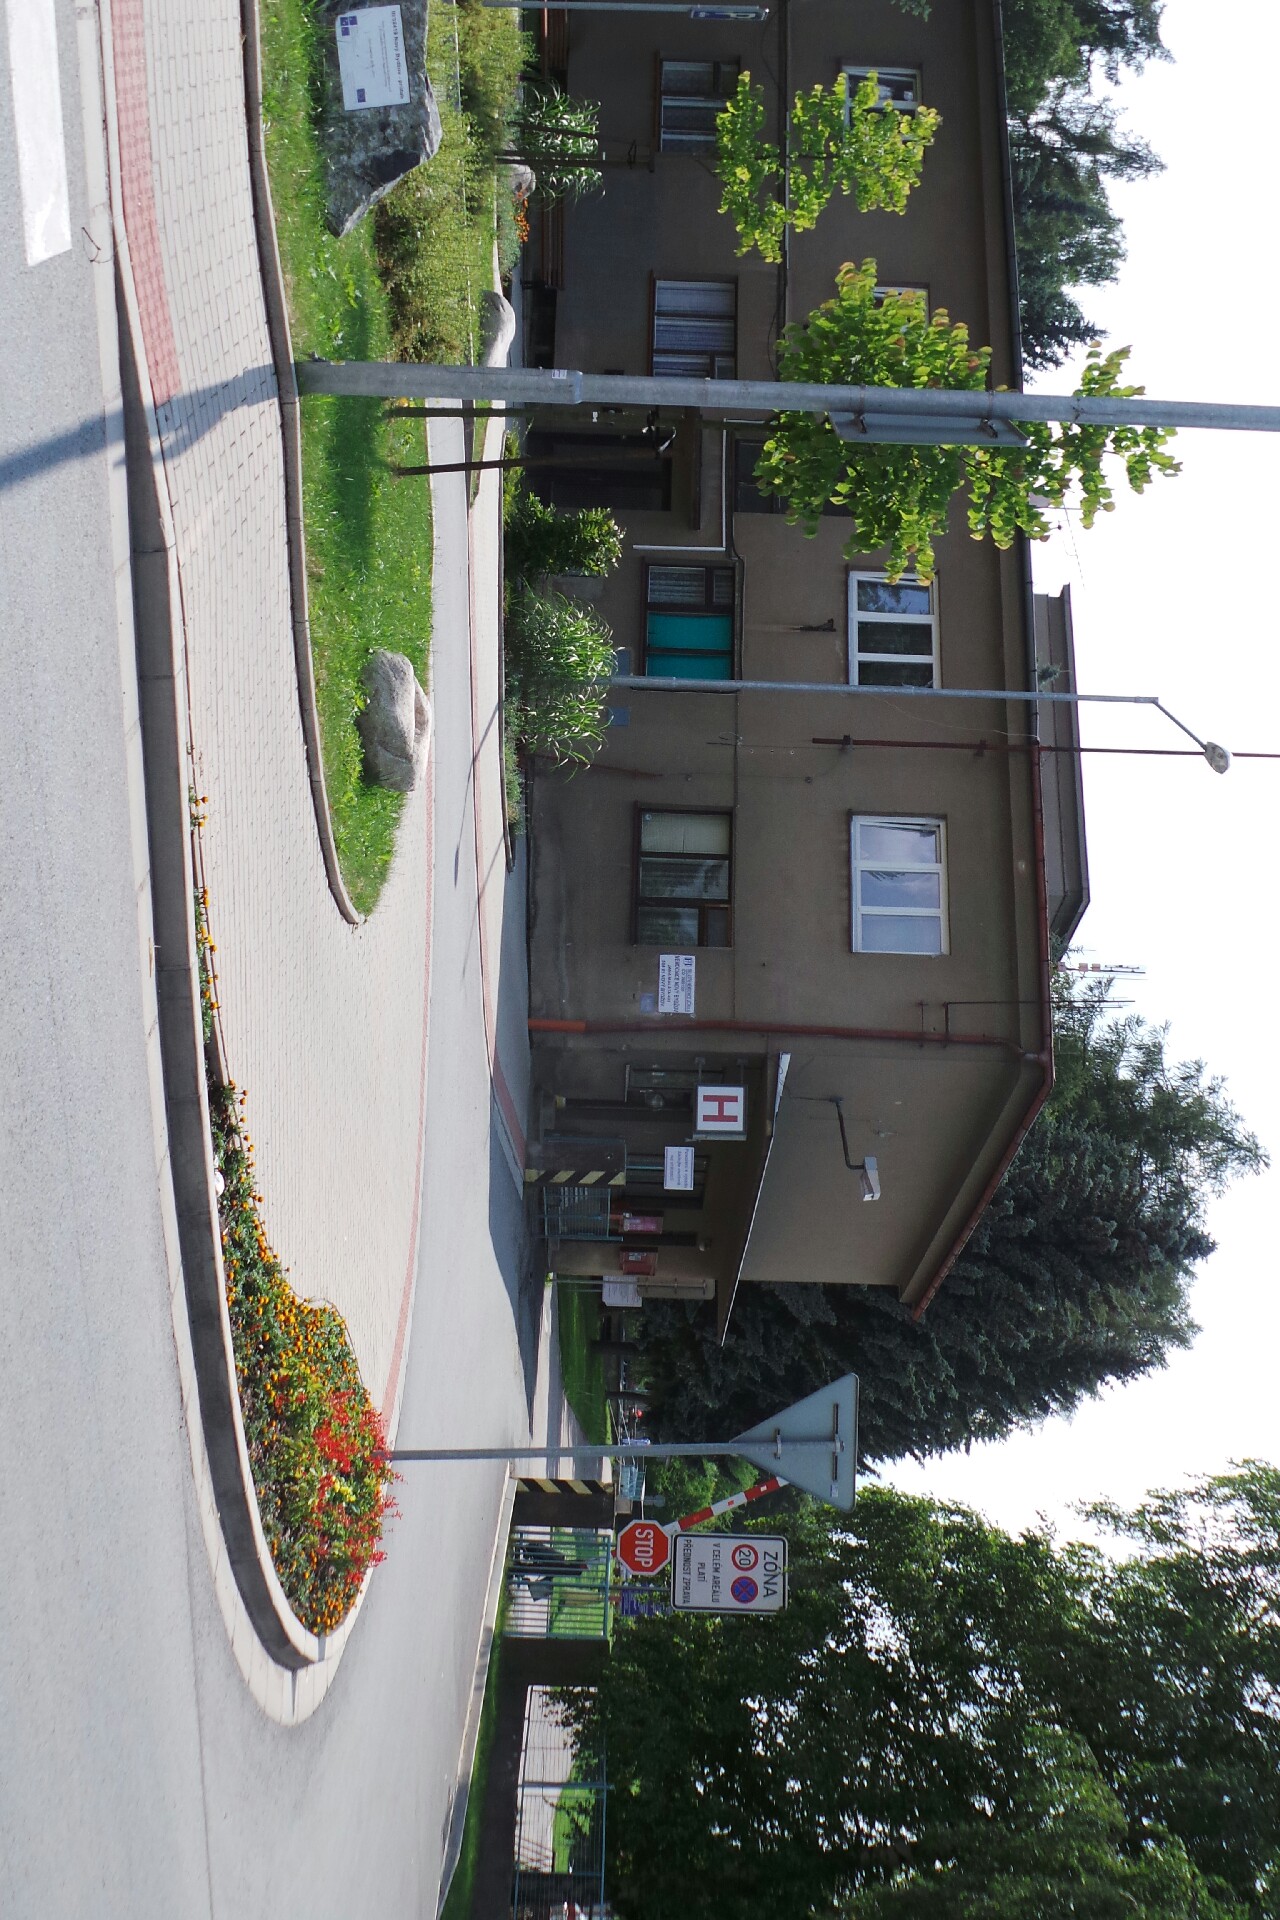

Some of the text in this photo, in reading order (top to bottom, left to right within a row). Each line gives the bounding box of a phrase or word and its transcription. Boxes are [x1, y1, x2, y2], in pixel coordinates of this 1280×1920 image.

[702, 1094, 738, 1122] H
[634, 1528, 654, 1567] STOP
[683, 1539, 693, 1575] PŘEDNOST
[712, 1550, 723, 1573] CELÉM
[738, 1550, 751, 1566] 20
[698, 1562, 707, 1582] PLATÍ
[763, 1551, 781, 1598] ZÓNA
[712, 1575, 722, 1603] AREÁLU
